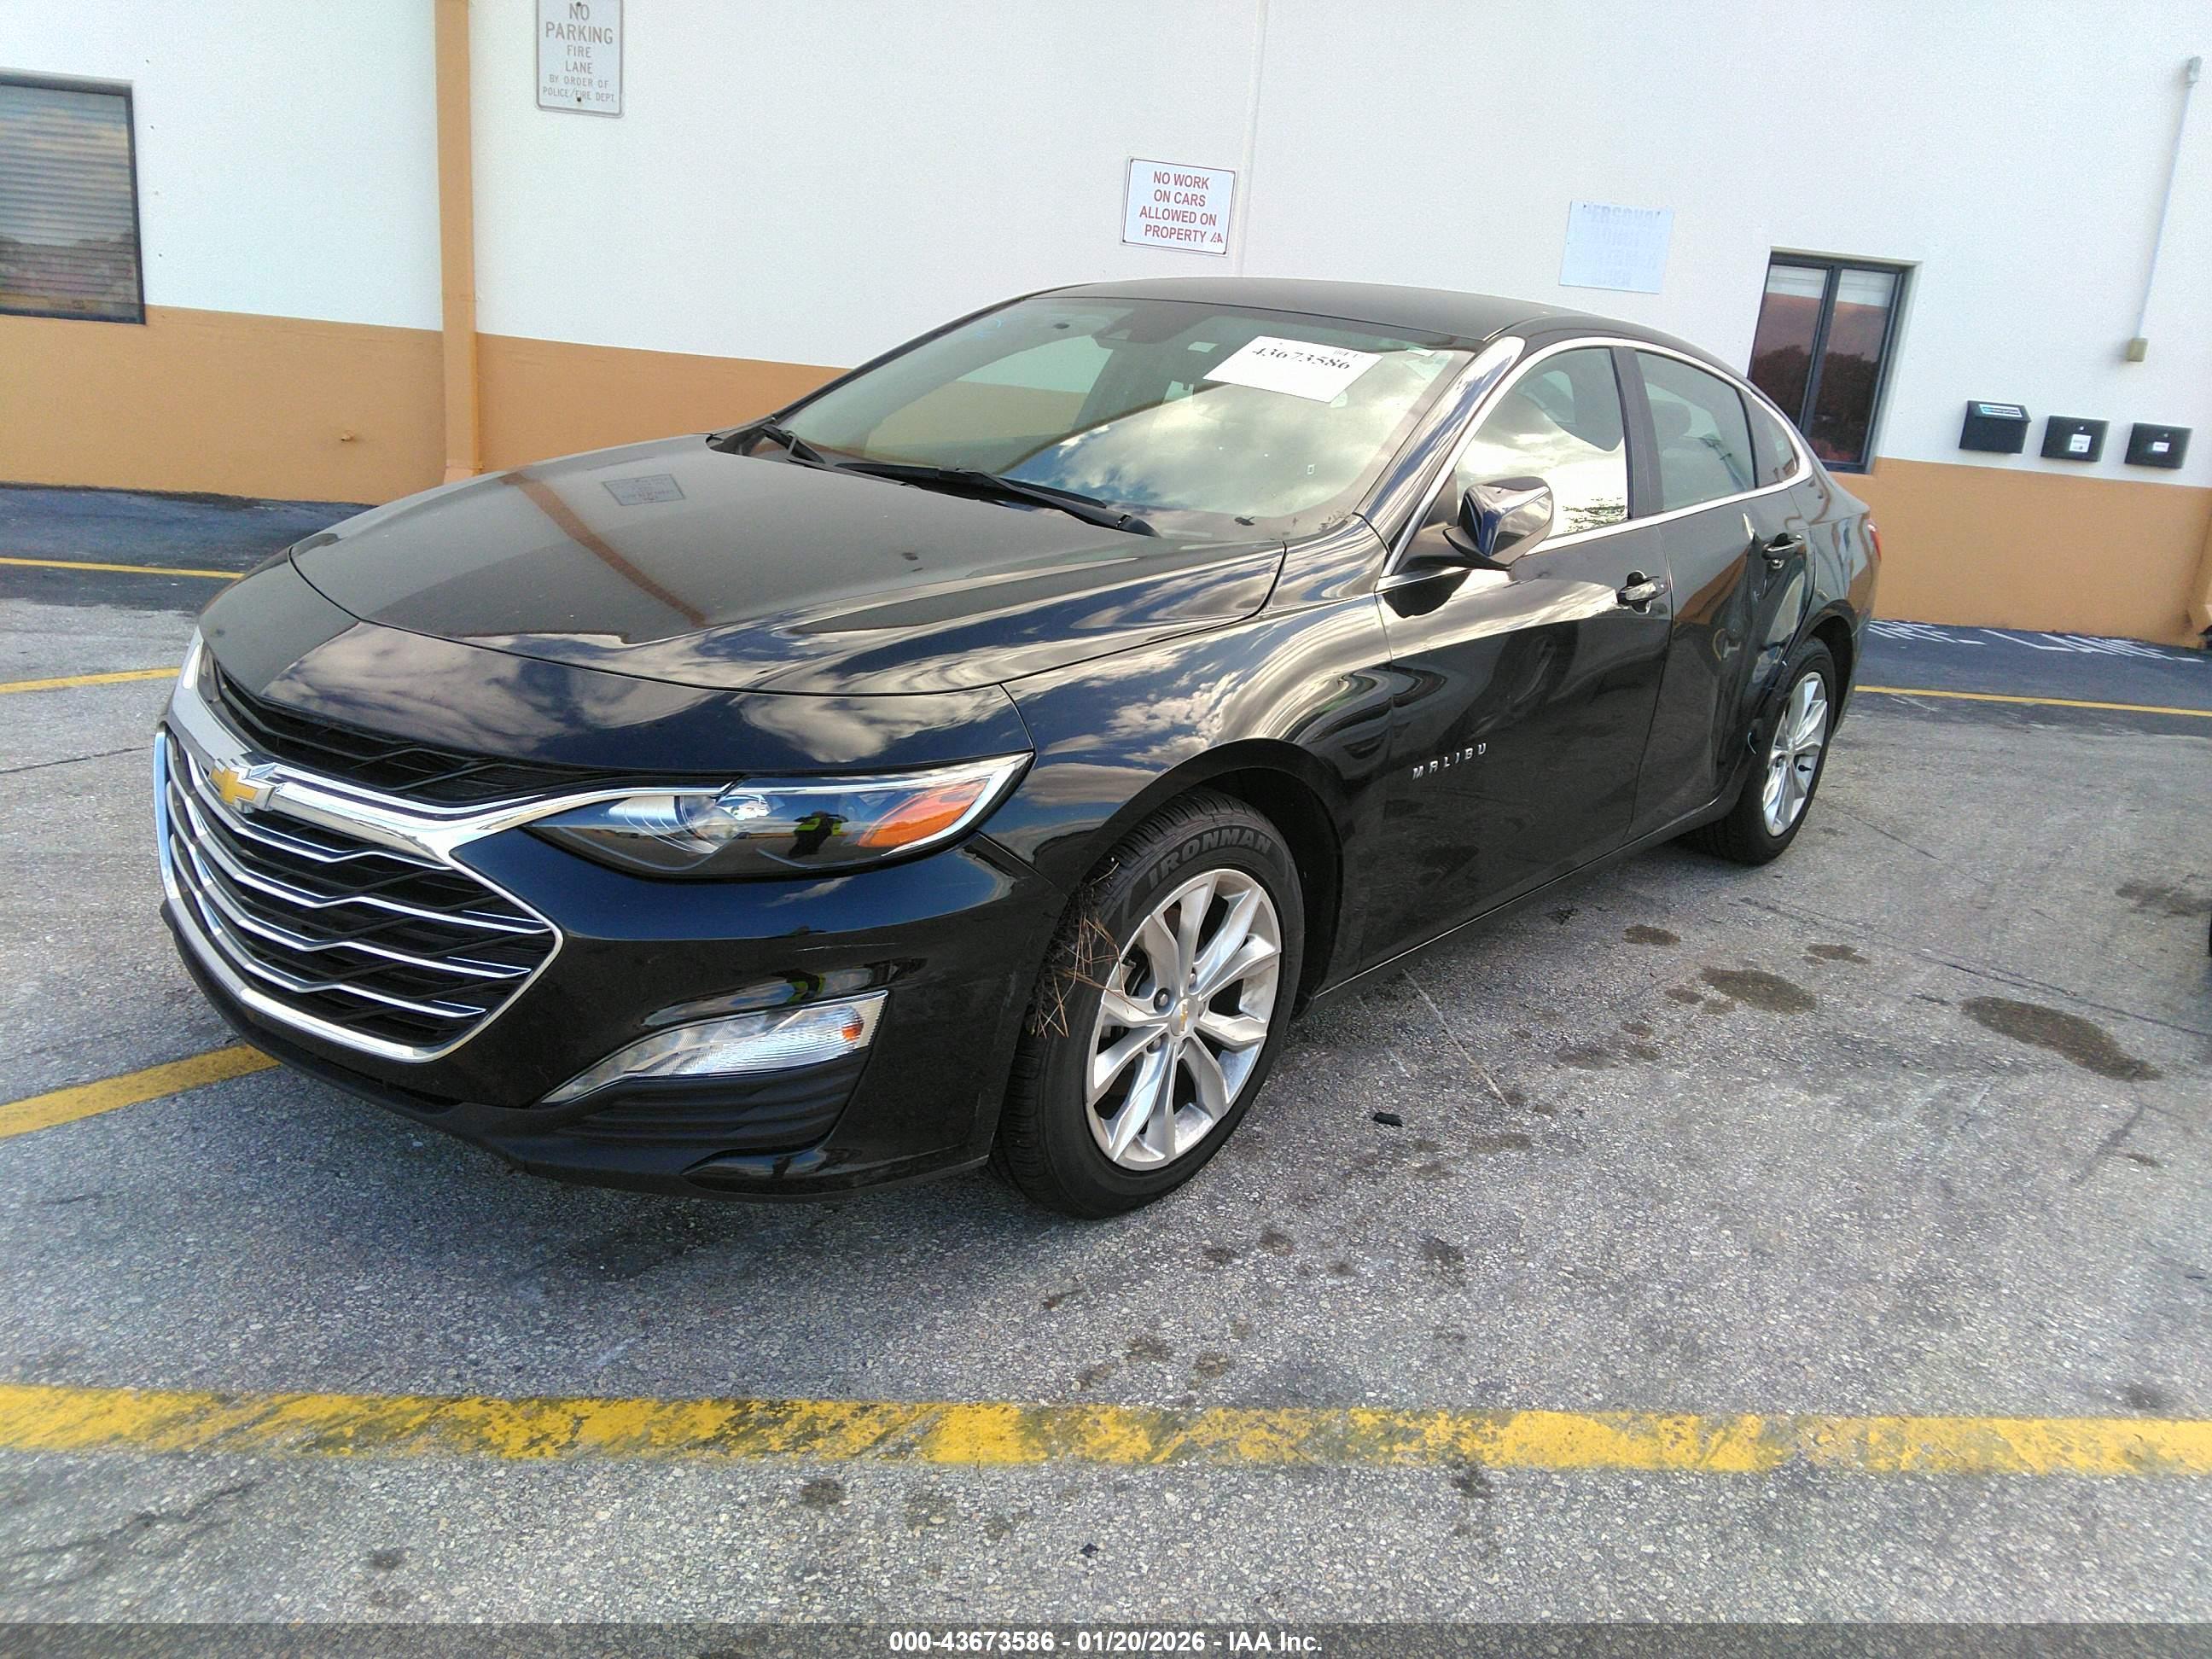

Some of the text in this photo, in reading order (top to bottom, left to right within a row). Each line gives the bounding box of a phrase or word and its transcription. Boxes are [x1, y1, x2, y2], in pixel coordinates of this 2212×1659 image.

[569, 3, 590, 20] NO
[545, 21, 614, 44] PARKING
[567, 44, 591, 58] FIRE
[565, 61, 593, 74] LANE
[549, 74, 609, 89] BY ORDER OF
[1153, 171, 1210, 189] NO WORK
[1154, 189, 1206, 207] ON CARS
[1139, 206, 1217, 226] ALLOWED ON
[1144, 224, 1207, 242] PROPERTY
[1412, 742, 1487, 780] MALIBU
[1149, 828, 1272, 889] IRONMAN
